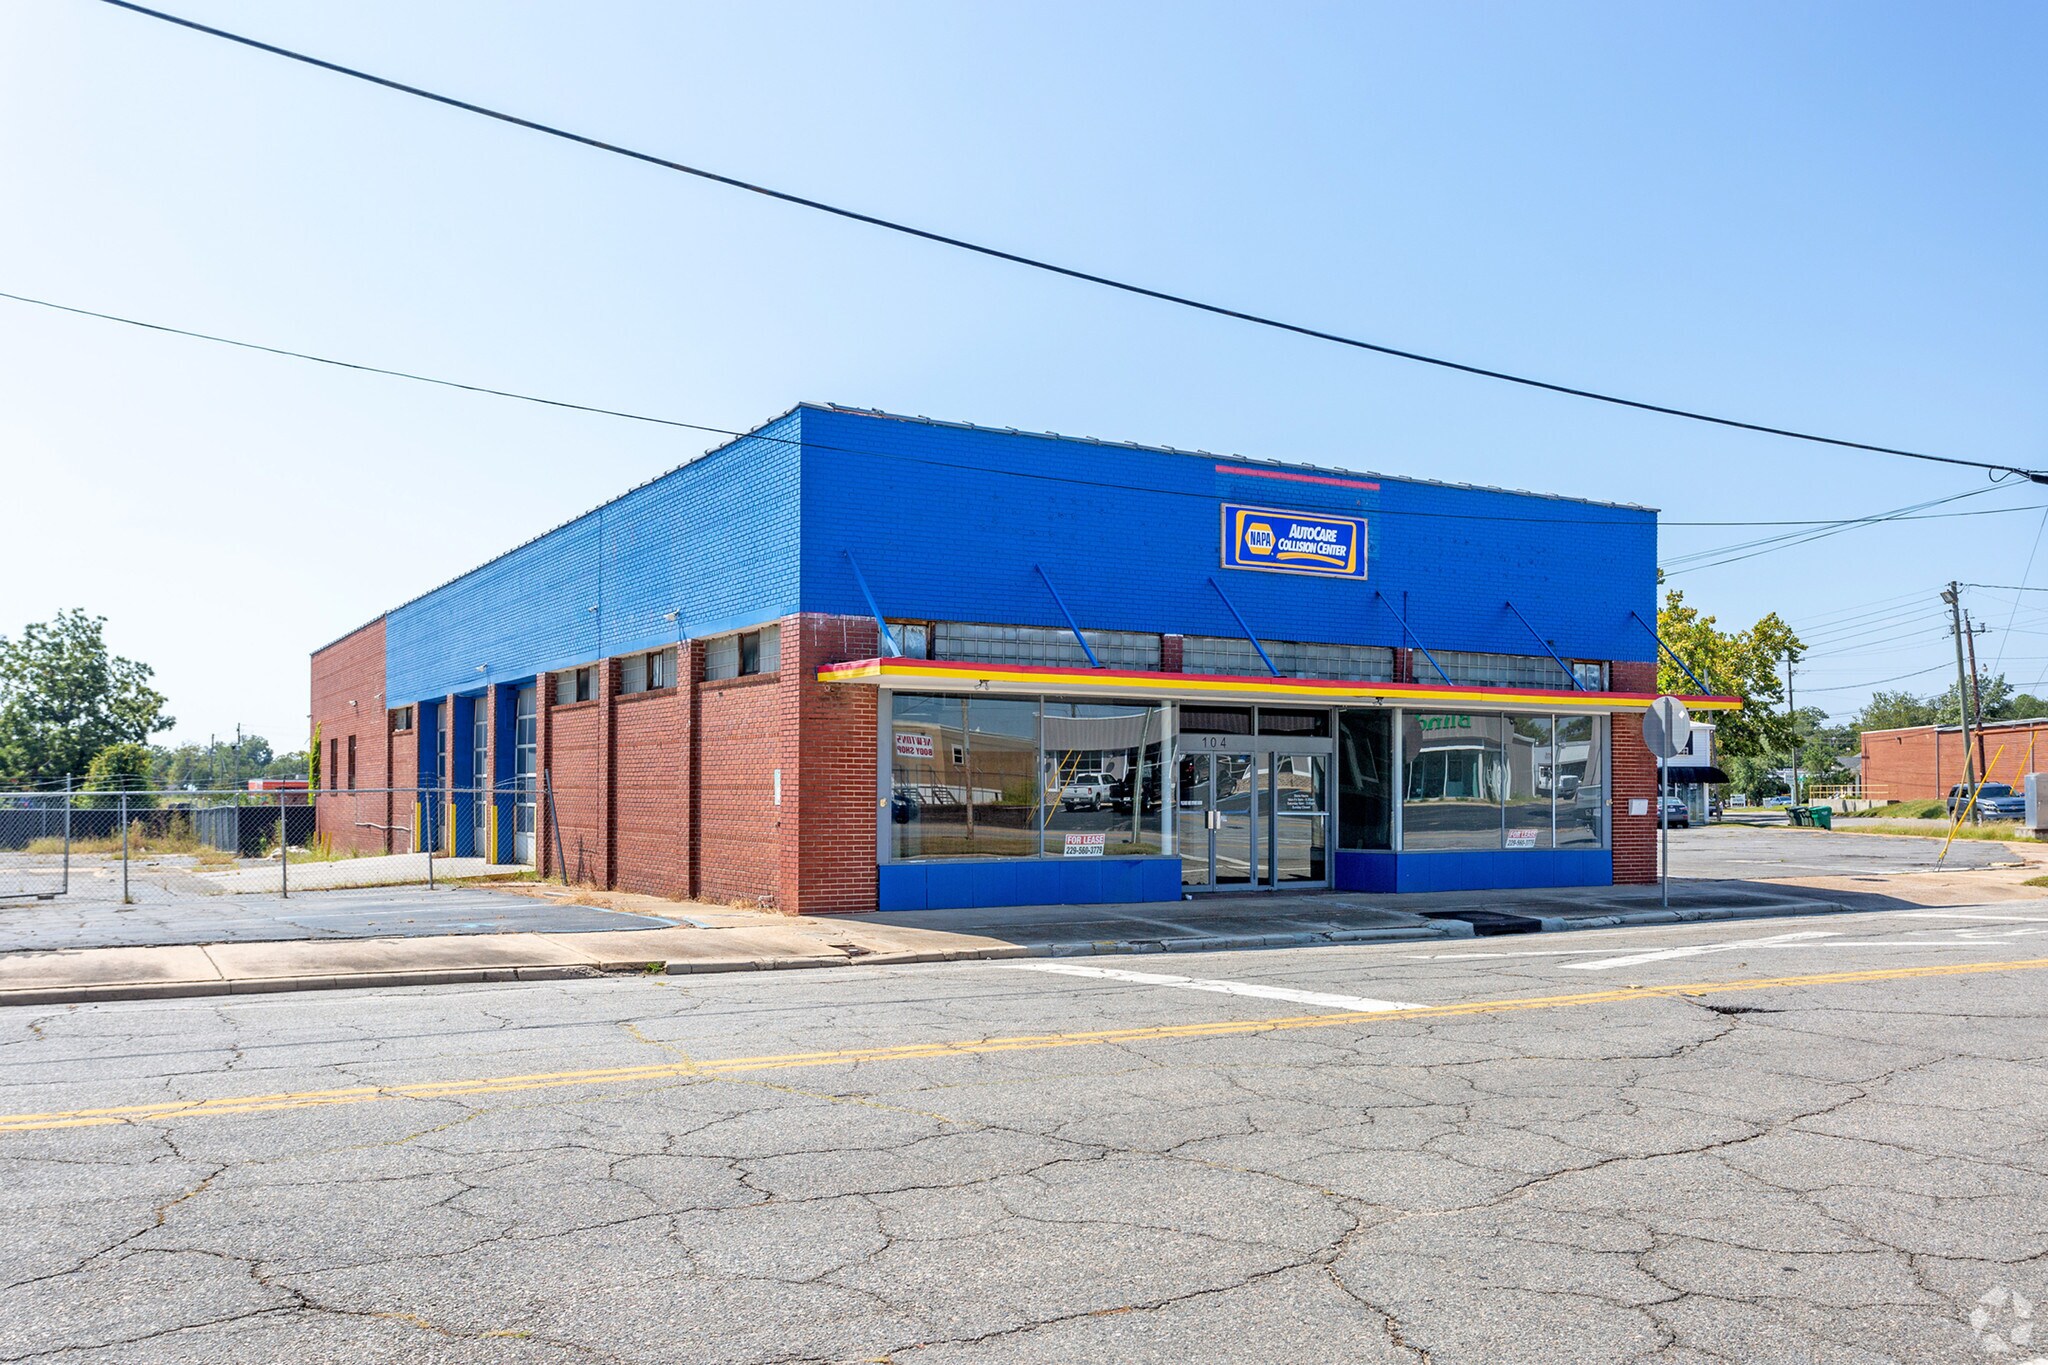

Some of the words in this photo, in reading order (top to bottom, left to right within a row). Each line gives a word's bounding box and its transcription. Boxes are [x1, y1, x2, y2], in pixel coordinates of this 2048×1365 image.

[1250, 530, 1272, 547] NAPA
[1278, 538, 1317, 554] COLLISION
[1317, 542, 1347, 556] CENTER
[1202, 737, 1227, 748] 104
[1067, 835, 1082, 845] FOR
[1083, 835, 1104, 845] LEASE
